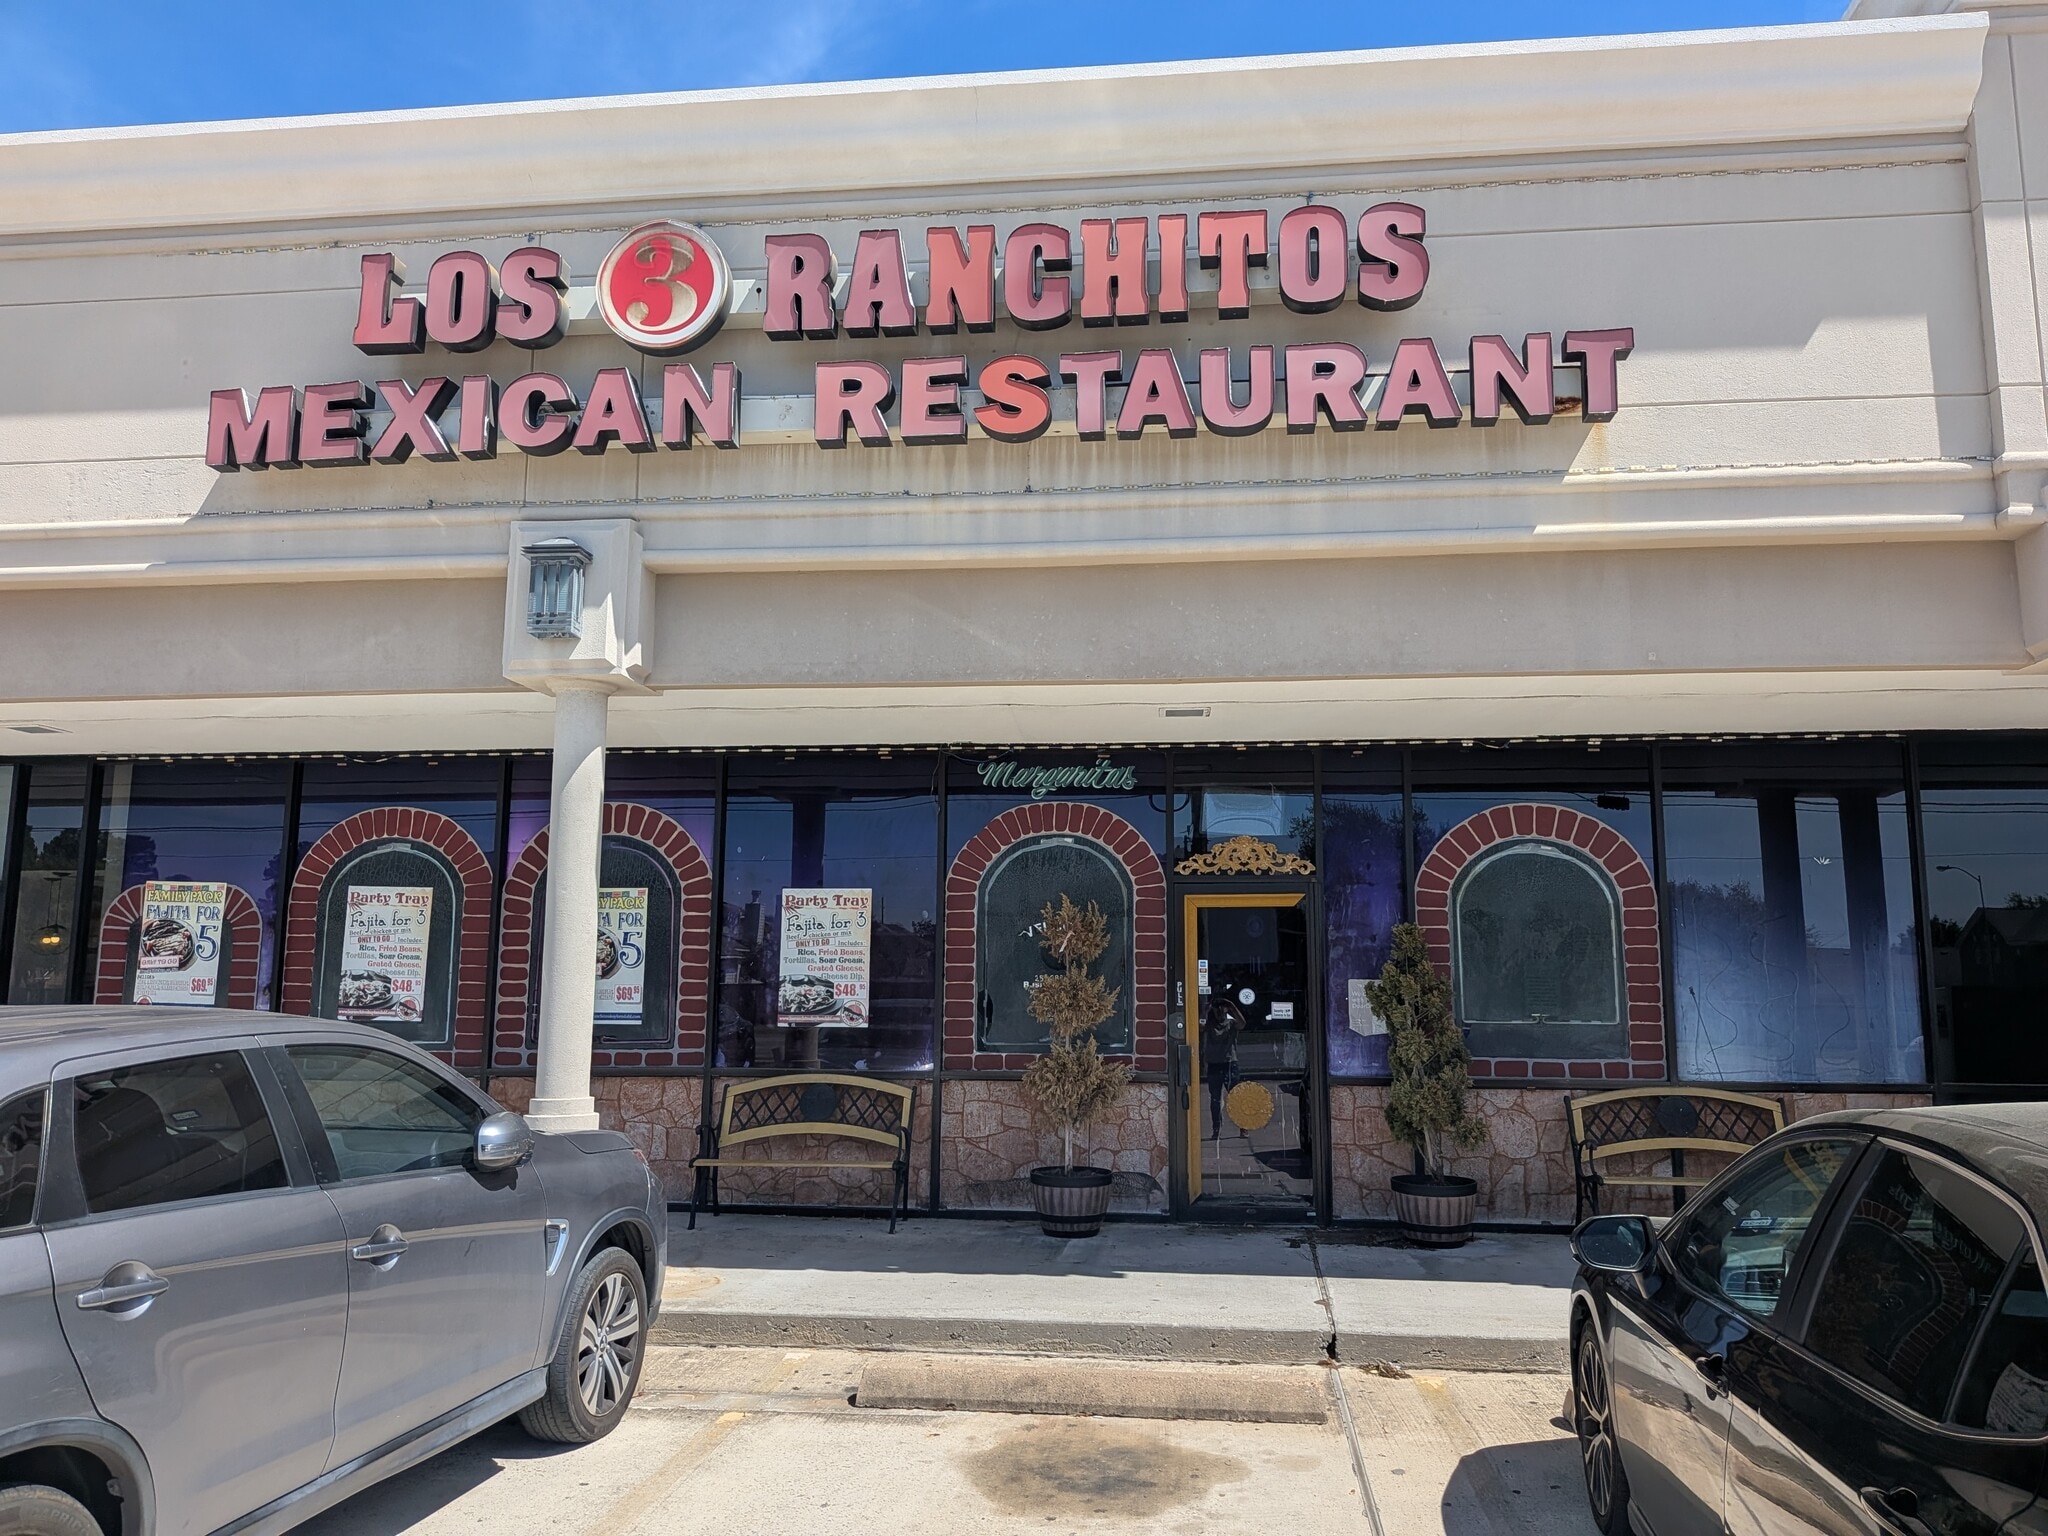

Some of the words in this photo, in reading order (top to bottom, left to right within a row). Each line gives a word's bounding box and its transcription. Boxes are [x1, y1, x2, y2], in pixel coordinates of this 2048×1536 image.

[352, 247, 570, 355] LOS
[764, 201, 1431, 341] RANCHITOS
[206, 361, 741, 473] MEXICAN
[815, 327, 1635, 450] RESTAURANT
[977, 759, 1138, 800] Margaritas
[147, 890, 188, 903] FAMILY
[350, 891, 391, 906] Party
[395, 892, 430, 907] Tray
[785, 894, 828, 909] Party
[832, 894, 869, 909] Tray
[146, 904, 190, 921] FAJITA
[197, 905, 221, 923] FOR
[350, 910, 387, 933] Fajita
[392, 910, 412, 926] for
[416, 909, 426, 925] 3
[618, 911, 644, 930] FOR
[786, 914, 825, 937] Fajita
[831, 913, 851, 929] for
[856, 911, 867, 928] 3
[195, 924, 219, 961] 5
[357, 936, 373, 944] ONLY
[378, 944, 398, 952] Fried
[795, 940, 811, 948] ONLY
[812, 939, 820, 947] TO
[821, 938, 831, 946] GO
[618, 931, 644, 969] 5
[818, 948, 838, 956] Fried
[1176, 981, 1184, 1006] PULL
